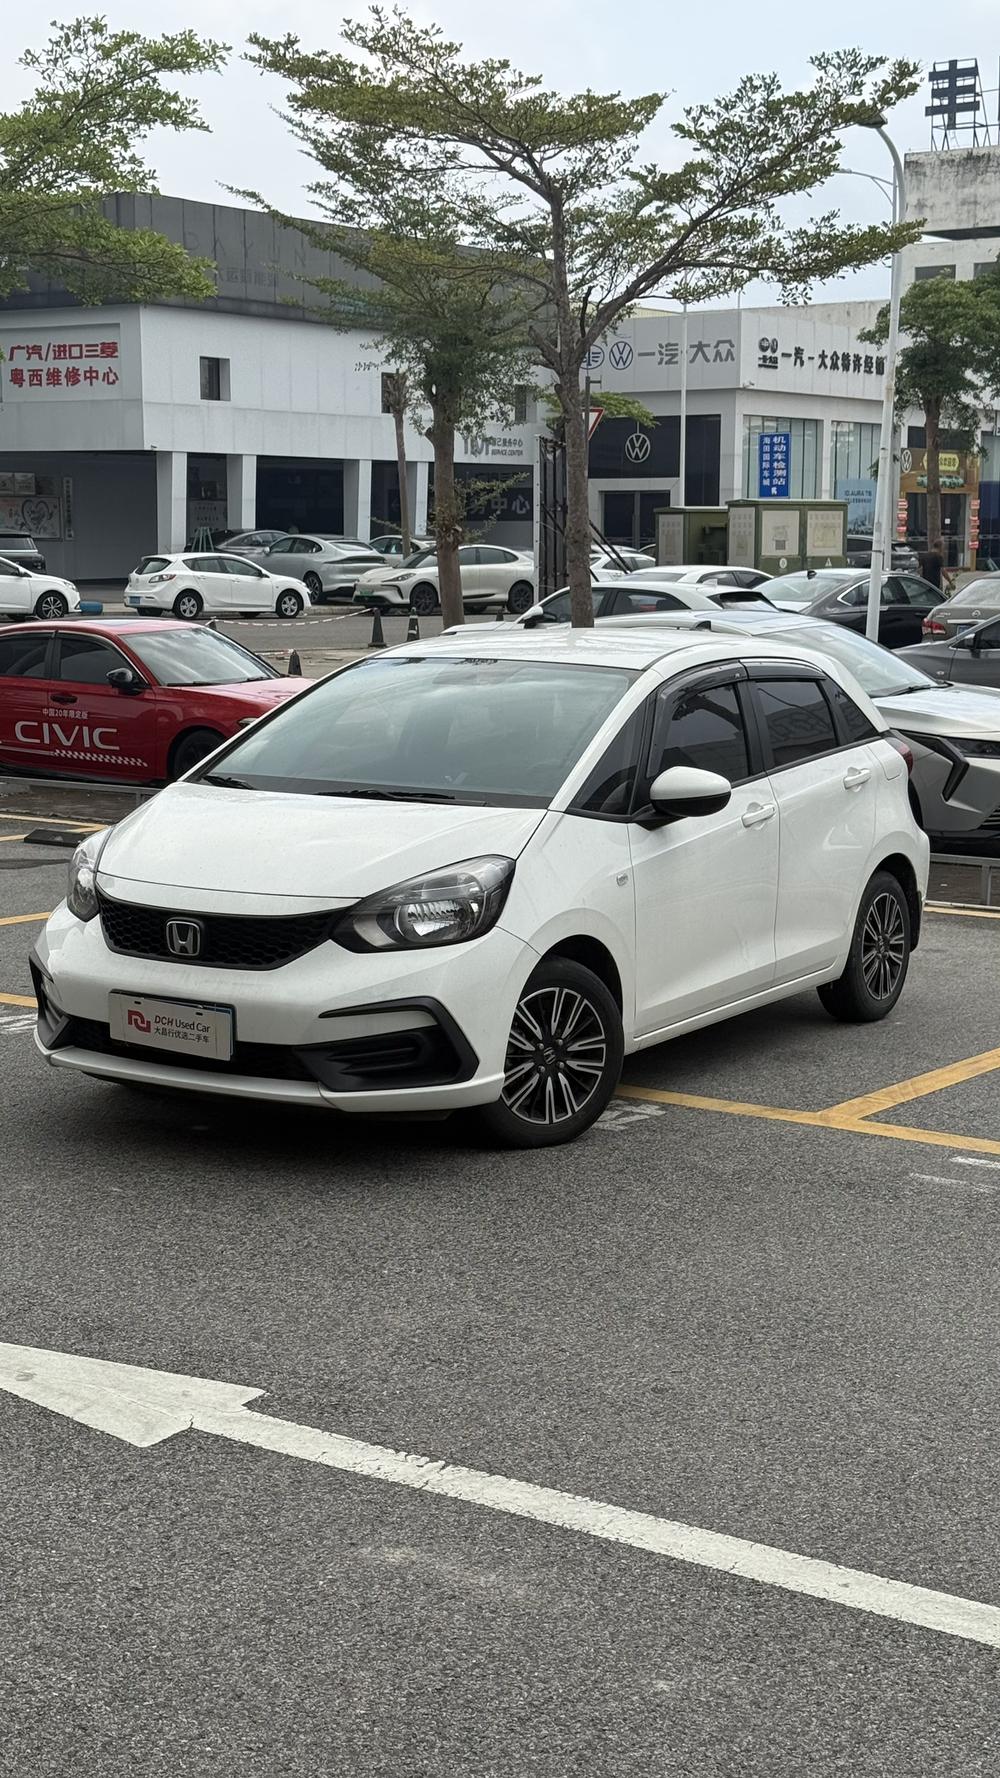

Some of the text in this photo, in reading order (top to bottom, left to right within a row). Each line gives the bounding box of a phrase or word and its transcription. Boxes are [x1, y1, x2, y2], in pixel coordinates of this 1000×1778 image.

[8, 342, 119, 361] 广汽/进口三菱
[638, 339, 735, 366] 一汽大众
[9, 366, 119, 388] 粤西维修中心
[772, 436, 787, 486] 机动车检测站
[15, 721, 120, 751] CIVIC
[154, 1015, 211, 1033] DCH Used Car
